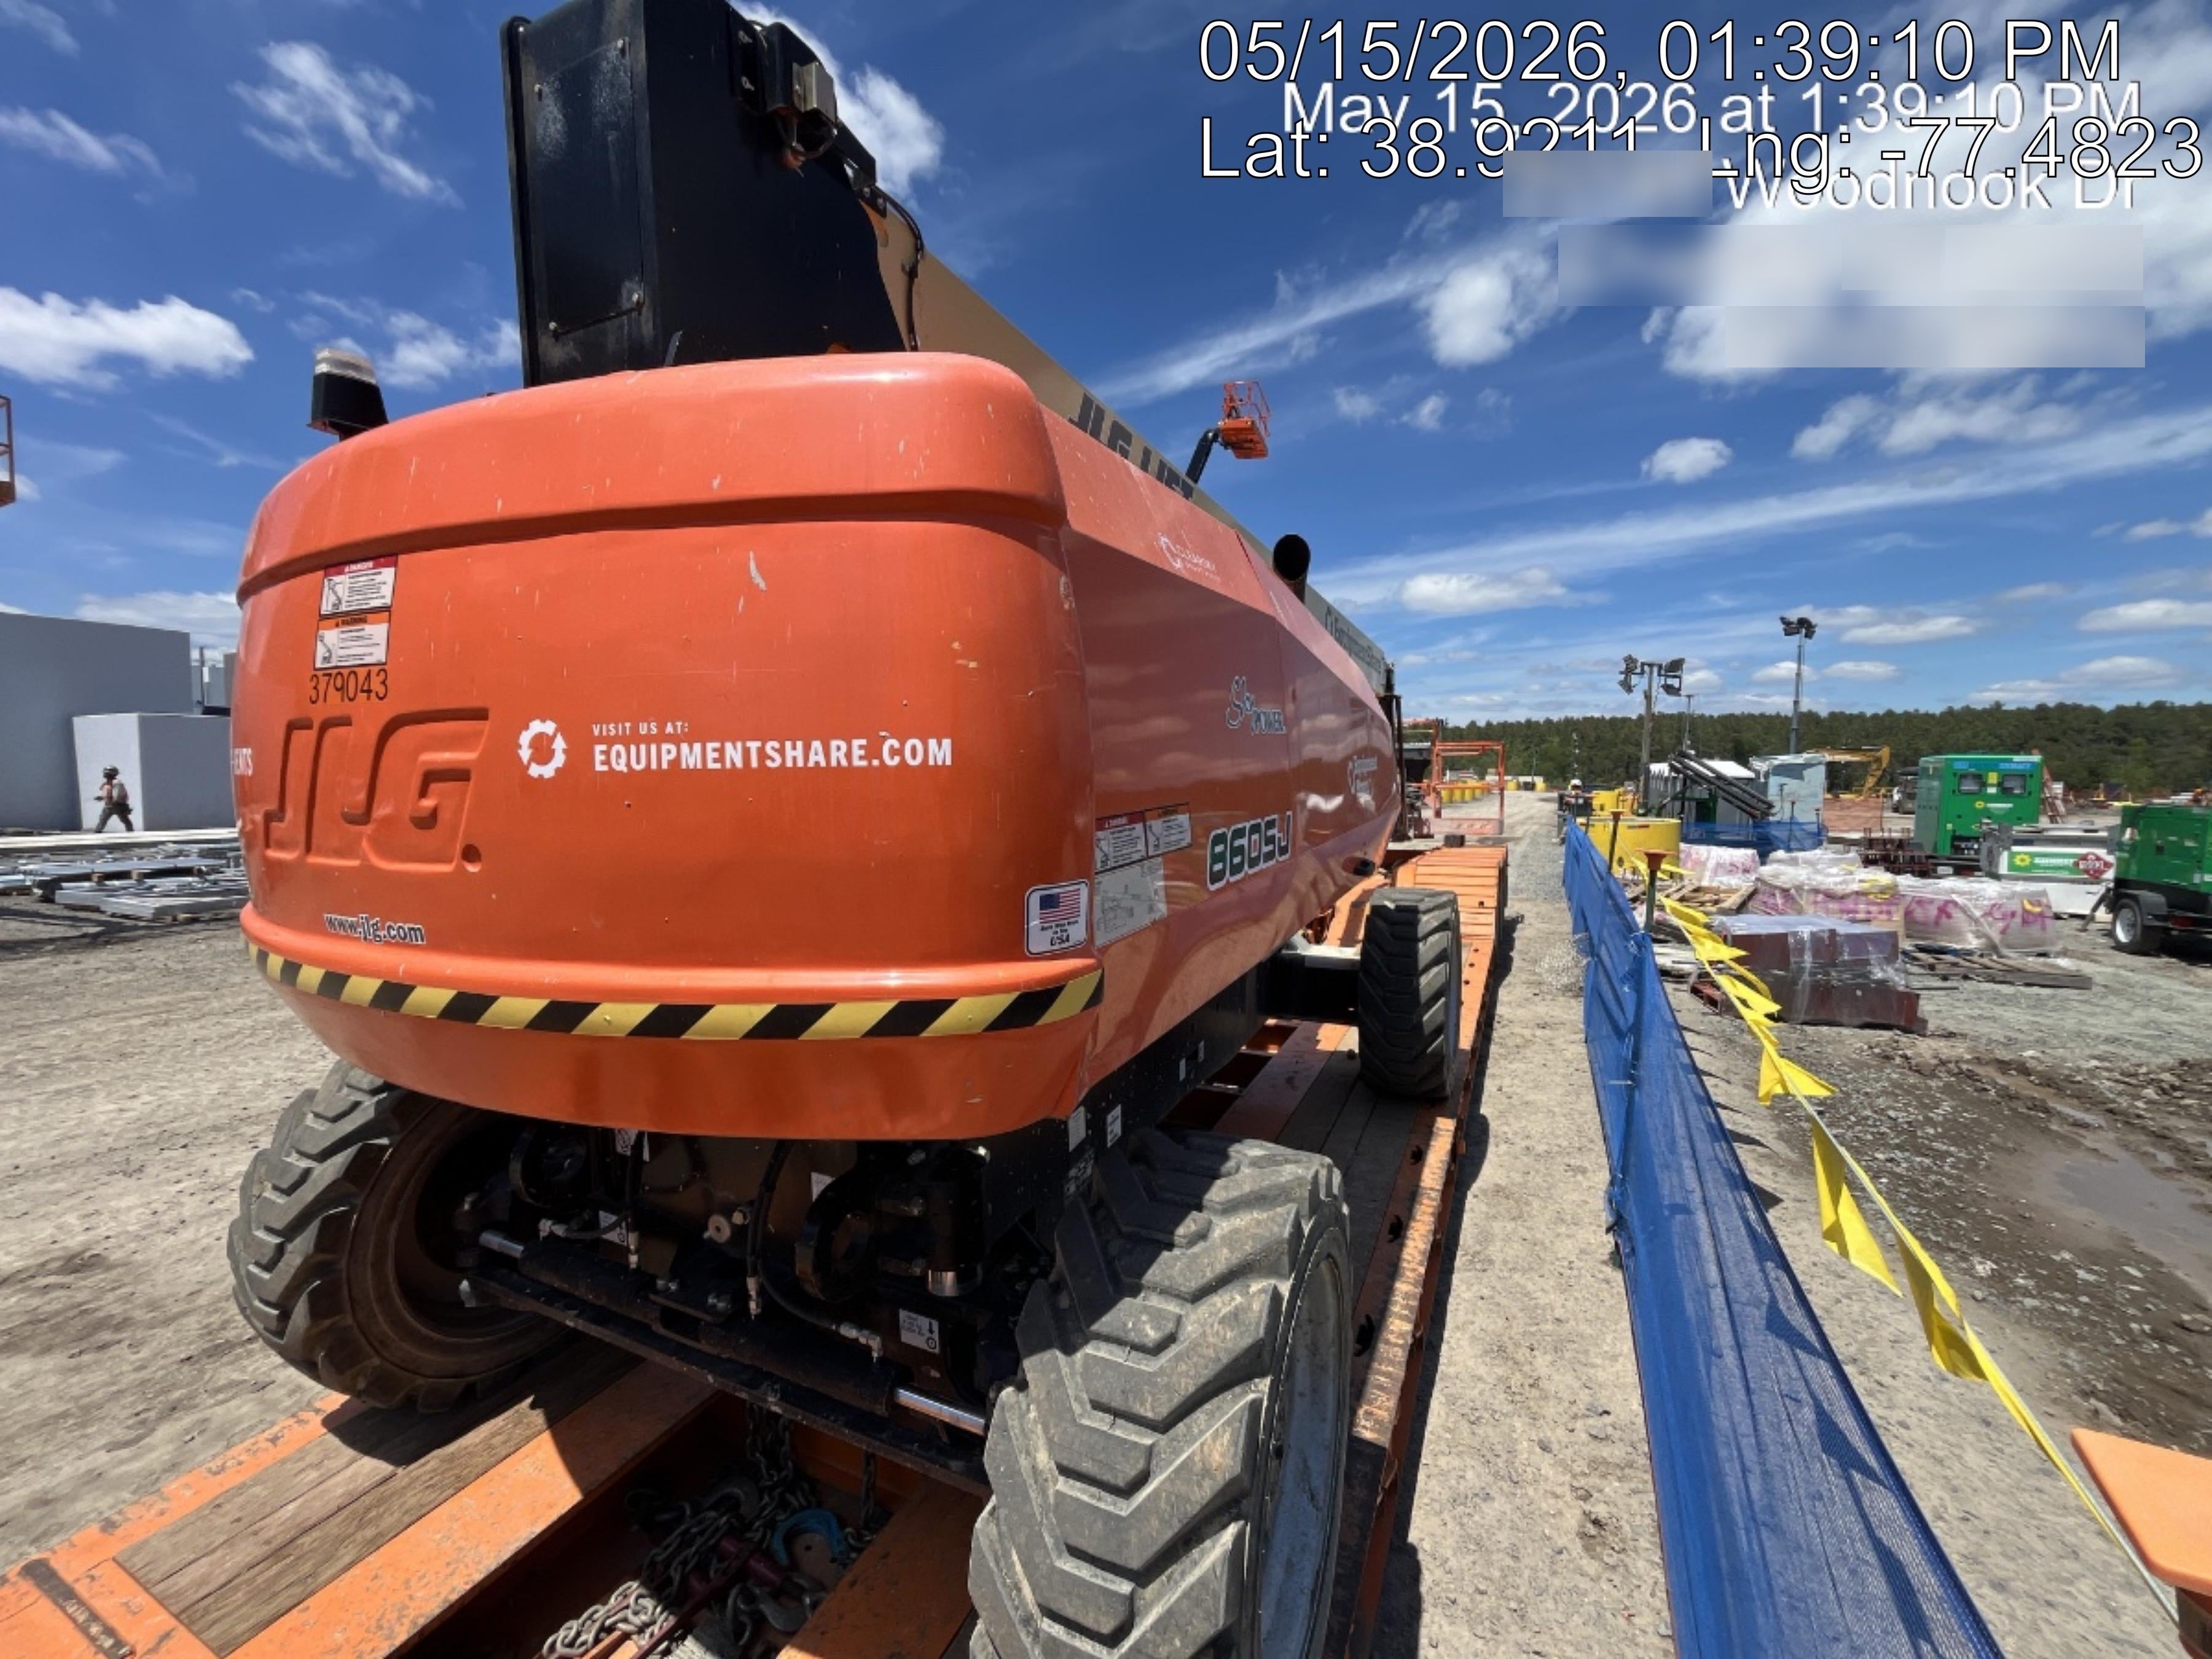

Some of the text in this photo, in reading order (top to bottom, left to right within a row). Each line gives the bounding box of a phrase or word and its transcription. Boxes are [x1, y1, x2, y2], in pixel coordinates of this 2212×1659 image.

[310, 668, 388, 705] 379043
[592, 721, 689, 737] VISIT US AT:
[593, 737, 952, 773] EQUIPMENTSHARE.COM
[263, 707, 490, 873] JLG
[1207, 810, 1292, 891] 860SJ
[324, 914, 426, 944] www.jlg.com
